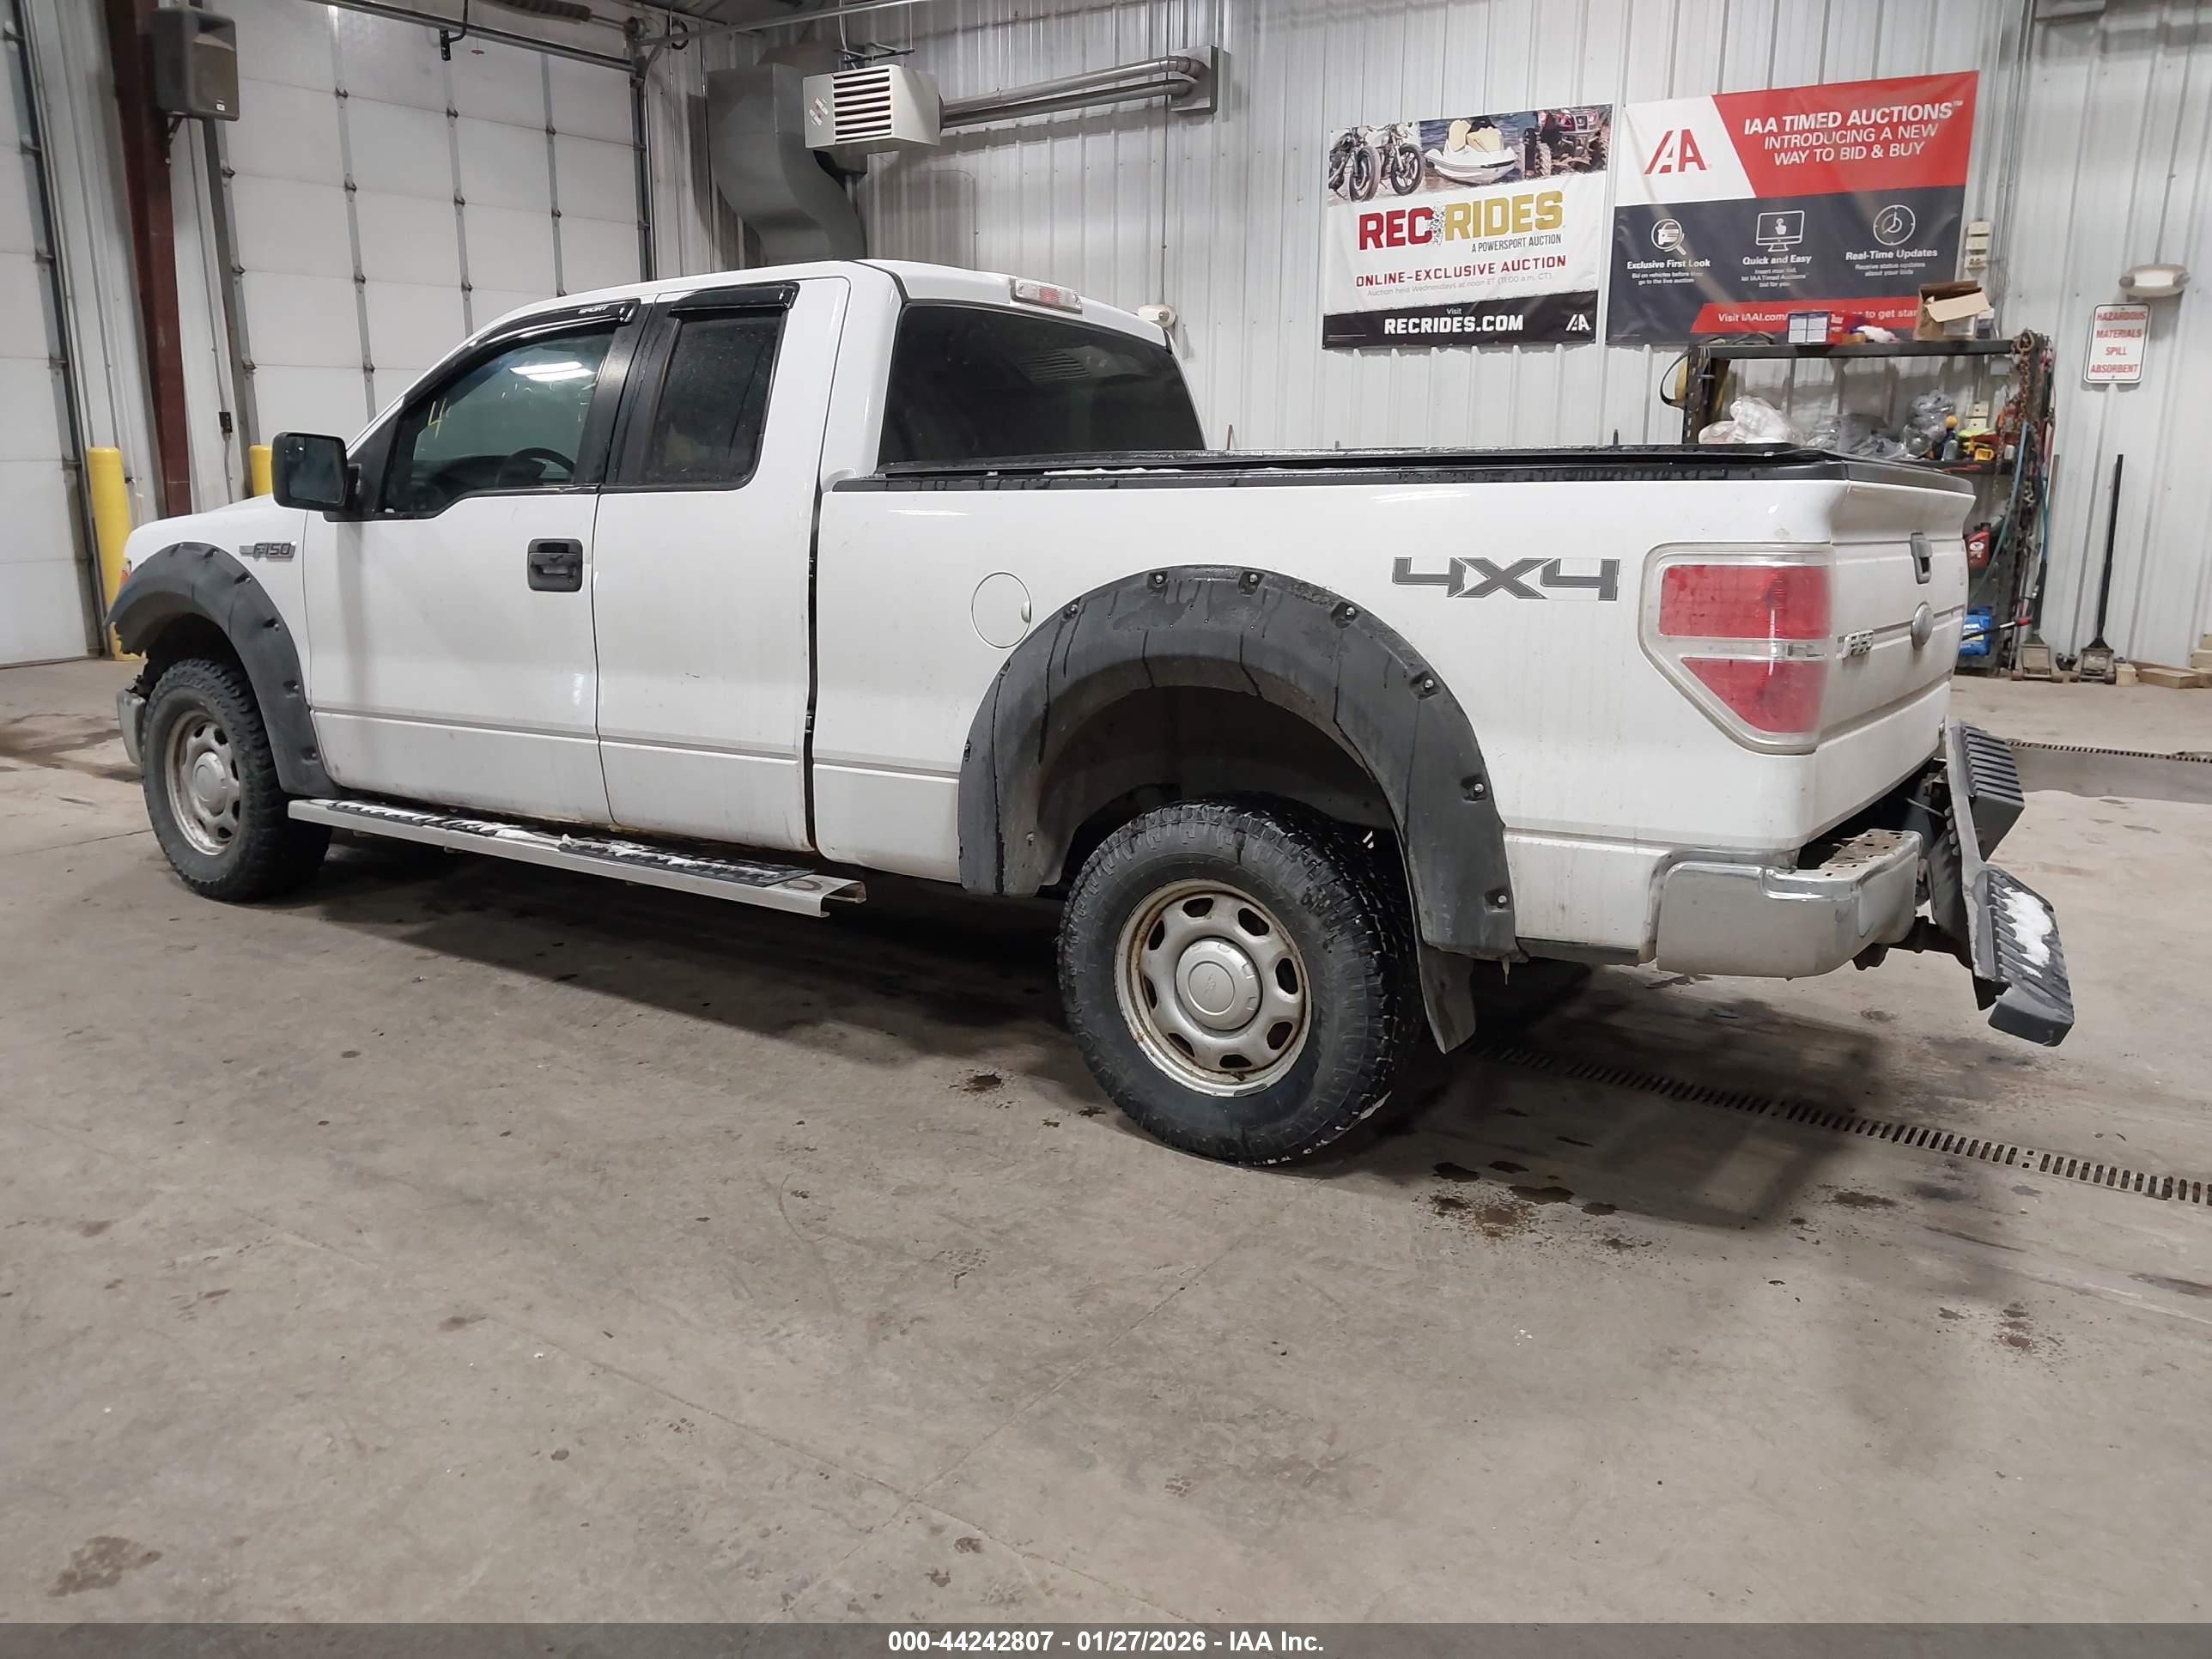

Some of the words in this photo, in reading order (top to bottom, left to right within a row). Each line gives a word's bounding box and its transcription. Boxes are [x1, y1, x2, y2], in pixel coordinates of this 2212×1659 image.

[1744, 118, 1778, 135] IAA
[1782, 112, 1842, 131] TIMED
[1765, 128, 1875, 149] INTRODUCING
[1880, 127, 1893, 141] A
[1898, 123, 1939, 139] NEW
[1774, 150, 1809, 166] WAY
[1814, 148, 1834, 162] TO
[1839, 145, 1867, 161] BID
[1871, 144, 1883, 158] &
[1889, 142, 1925, 157] BUY
[1359, 207, 1433, 250] REC
[1445, 191, 1564, 241] RIDES
[1472, 243, 1477, 252] A
[1478, 238, 1526, 252] POWERSPORT
[1528, 234, 1561, 246] AUCTION
[1742, 256, 1769, 265] Quick
[1790, 254, 1812, 264] Easy
[1845, 251, 1893, 260] Real-Time
[1896, 249, 1937, 258] Updates
[1626, 260, 1665, 270] Exclusive
[1667, 259, 1686, 268] First
[1688, 258, 1711, 267] Look
[1356, 263, 1495, 287] ONLINE-EXCLUSIVE
[1501, 255, 1566, 272] AUCTION
[1865, 310, 1875, 319] to
[1878, 309, 1895, 320] get
[2096, 311, 2146, 321] HAZARDOUS
[1384, 314, 1523, 334] RECRIDES.COM
[2095, 329, 2142, 338] MATERIALS
[2105, 346, 2127, 356] SPILL
[2090, 363, 2139, 374] ABSORBENT
